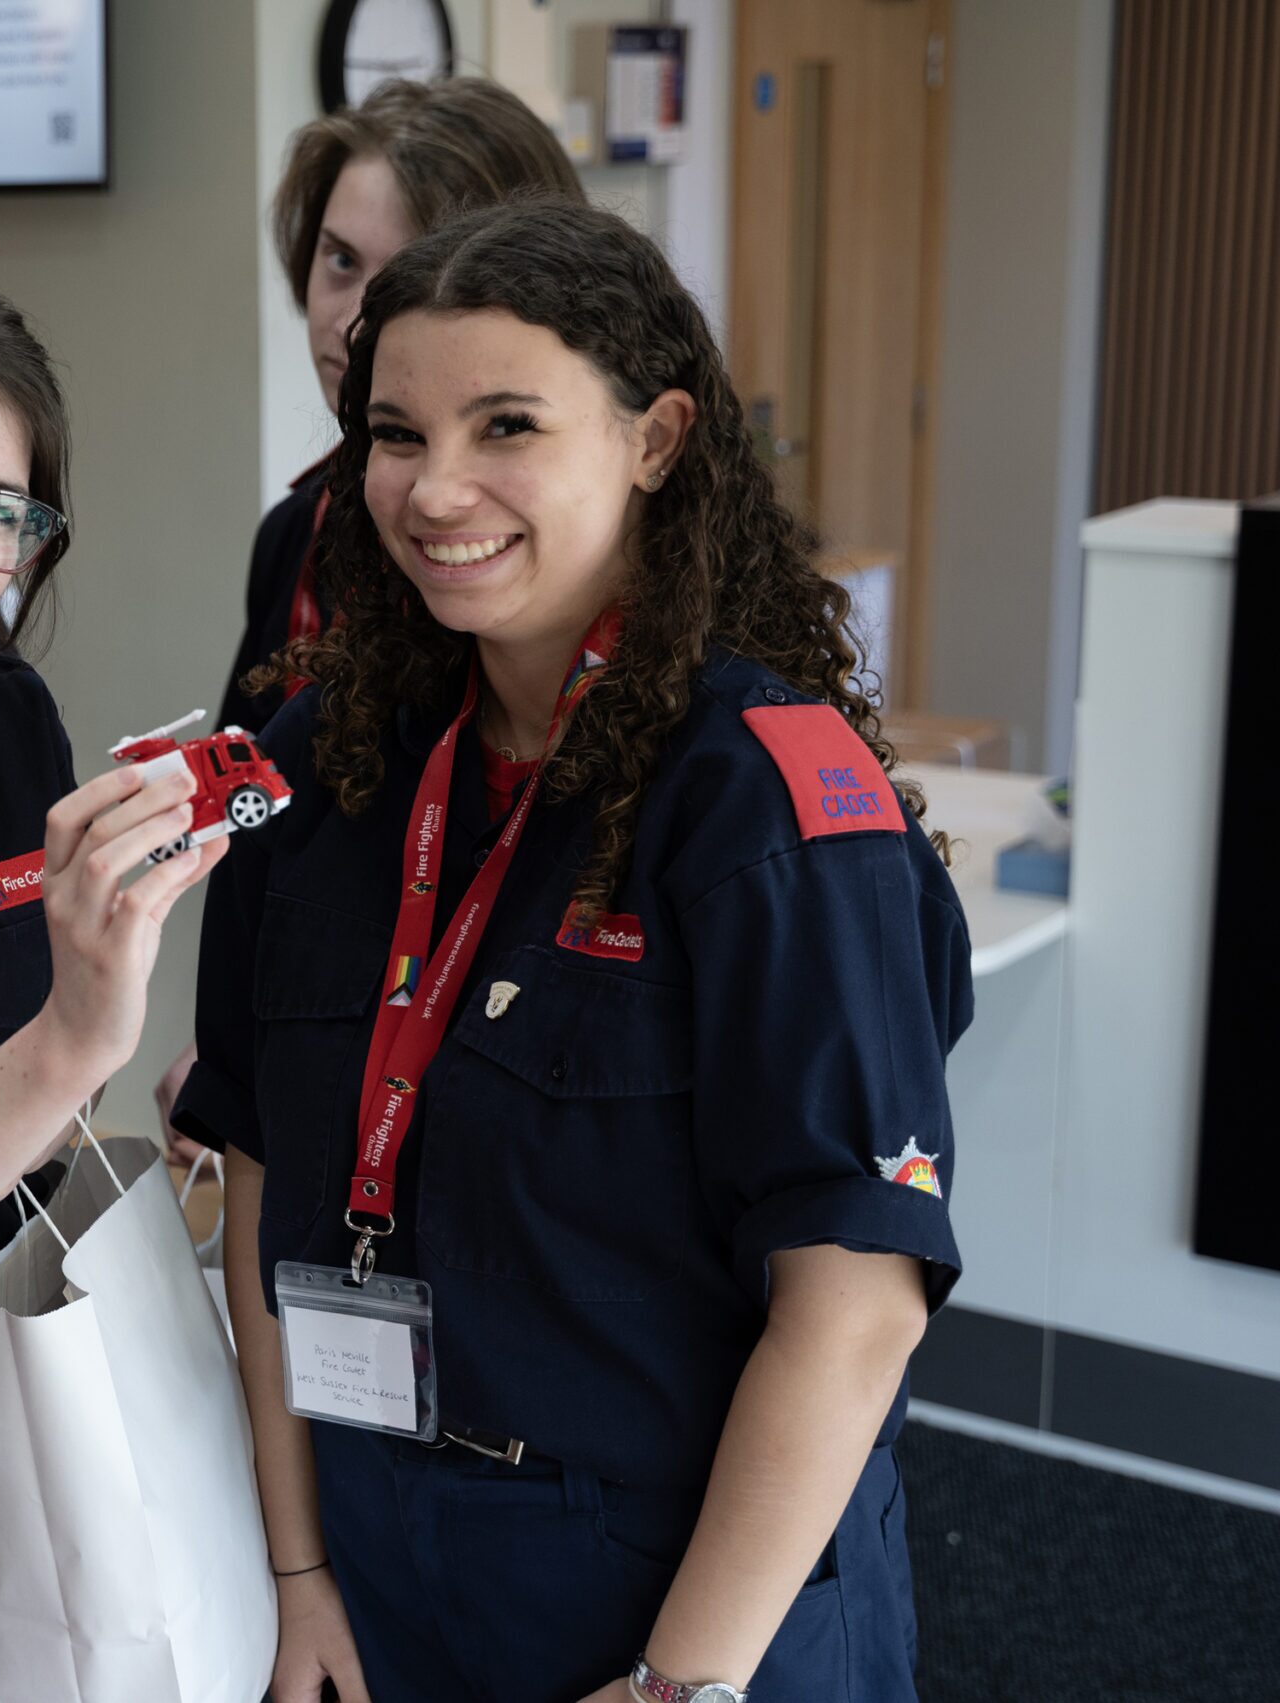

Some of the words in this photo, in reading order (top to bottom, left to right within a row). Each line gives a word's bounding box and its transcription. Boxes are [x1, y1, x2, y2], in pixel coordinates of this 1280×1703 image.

[818, 767, 862, 790] FIRE
[822, 791, 884, 819] CADET
[418, 804, 435, 851] Fighters
[432, 805, 443, 832] Charity
[416, 854, 429, 877] Fire
[1, 876, 26, 892] Fire
[421, 903, 479, 1019] firefighterscharity.org.uk
[385, 1094, 402, 1117] Fire
[363, 1134, 376, 1162] Charity
[371, 1118, 394, 1168] Fighters
[322, 1359, 339, 1371] Fire
[353, 1384, 370, 1395] Fire
